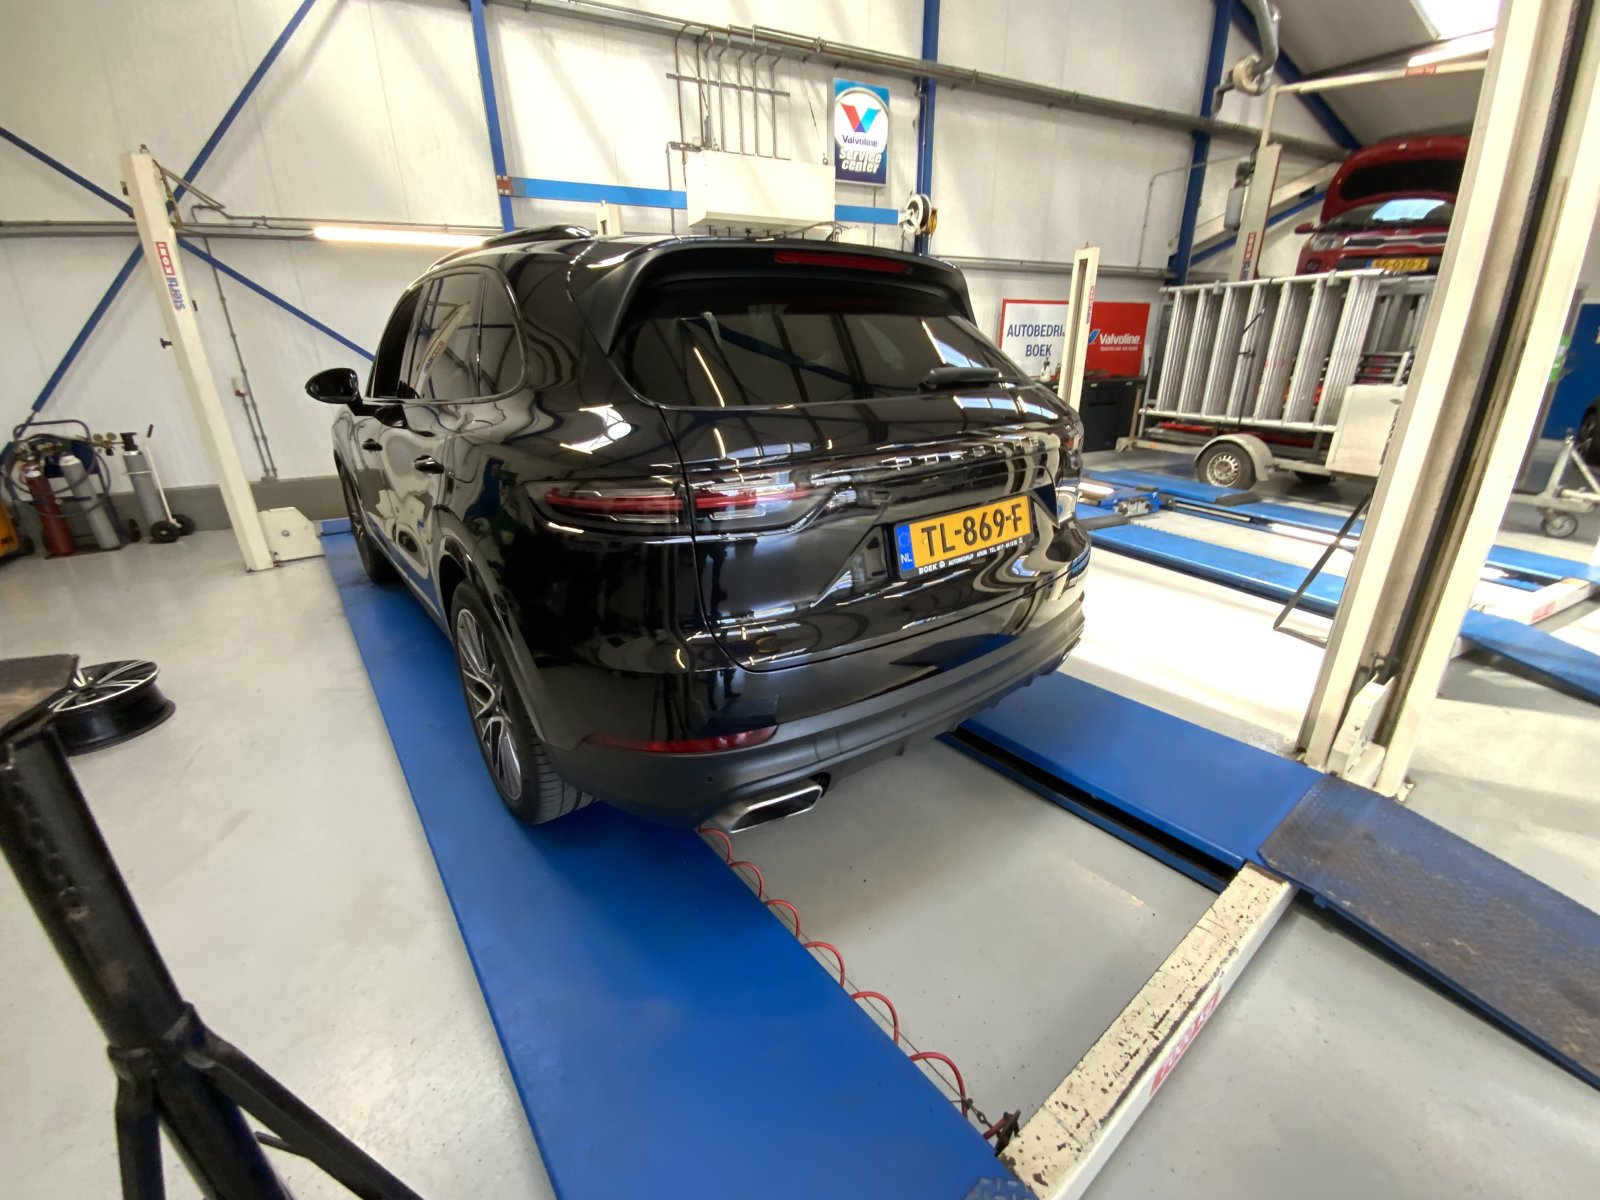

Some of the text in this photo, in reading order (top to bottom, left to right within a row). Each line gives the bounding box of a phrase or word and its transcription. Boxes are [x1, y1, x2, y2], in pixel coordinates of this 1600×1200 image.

[842, 134, 878, 148] Valvoline
[1100, 333, 1140, 345] Valvoline
[1025, 344, 1053, 357] BOEK
[921, 503, 1022, 557] TL-869-F
[900, 553, 913, 564] NL
[918, 563, 938, 575] BOEK
